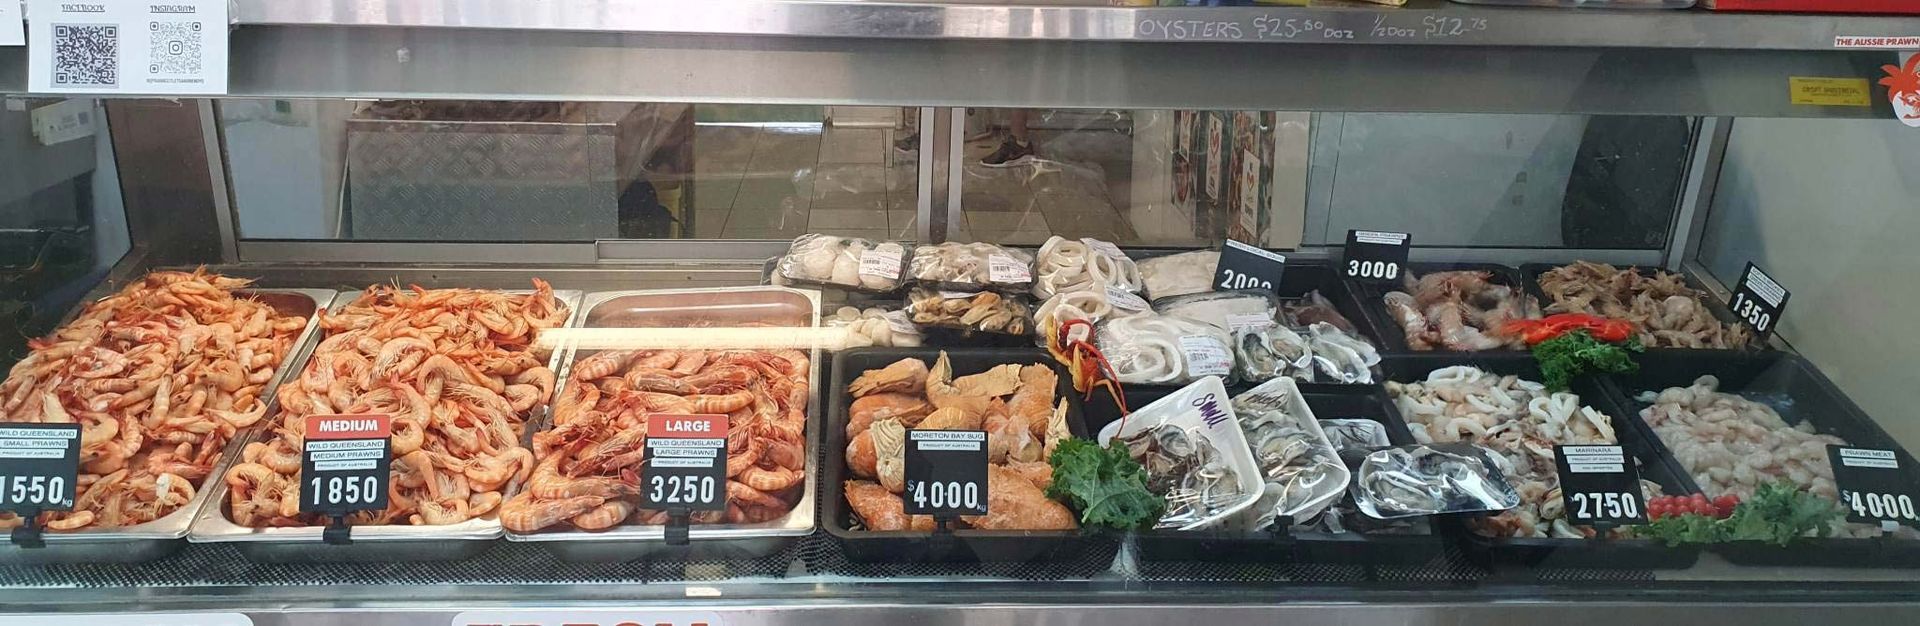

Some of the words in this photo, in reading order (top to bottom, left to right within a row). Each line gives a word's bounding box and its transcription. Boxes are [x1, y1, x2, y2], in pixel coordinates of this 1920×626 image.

[1139, 19, 1243, 39] OYSTERS
[1836, 38, 1852, 46] THE
[1855, 38, 1885, 46] AUSSIE
[1886, 38, 1920, 46] PRAWN
[1733, 292, 1770, 332] 1350
[319, 420, 378, 432] MEDIUM
[665, 420, 711, 432] LARGE
[20, 429, 75, 437] QUEENSLAND
[911, 432, 949, 440] MORETON
[967, 433, 983, 441] BUG
[3, 439, 30, 447] SMALL
[308, 442, 328, 450] WILD
[330, 441, 383, 449] QUEENSLAND
[313, 452, 345, 460] MEDIUM
[347, 450, 381, 459] PRAWNS
[311, 476, 378, 505] 1850
[650, 475, 715, 504] 3250
